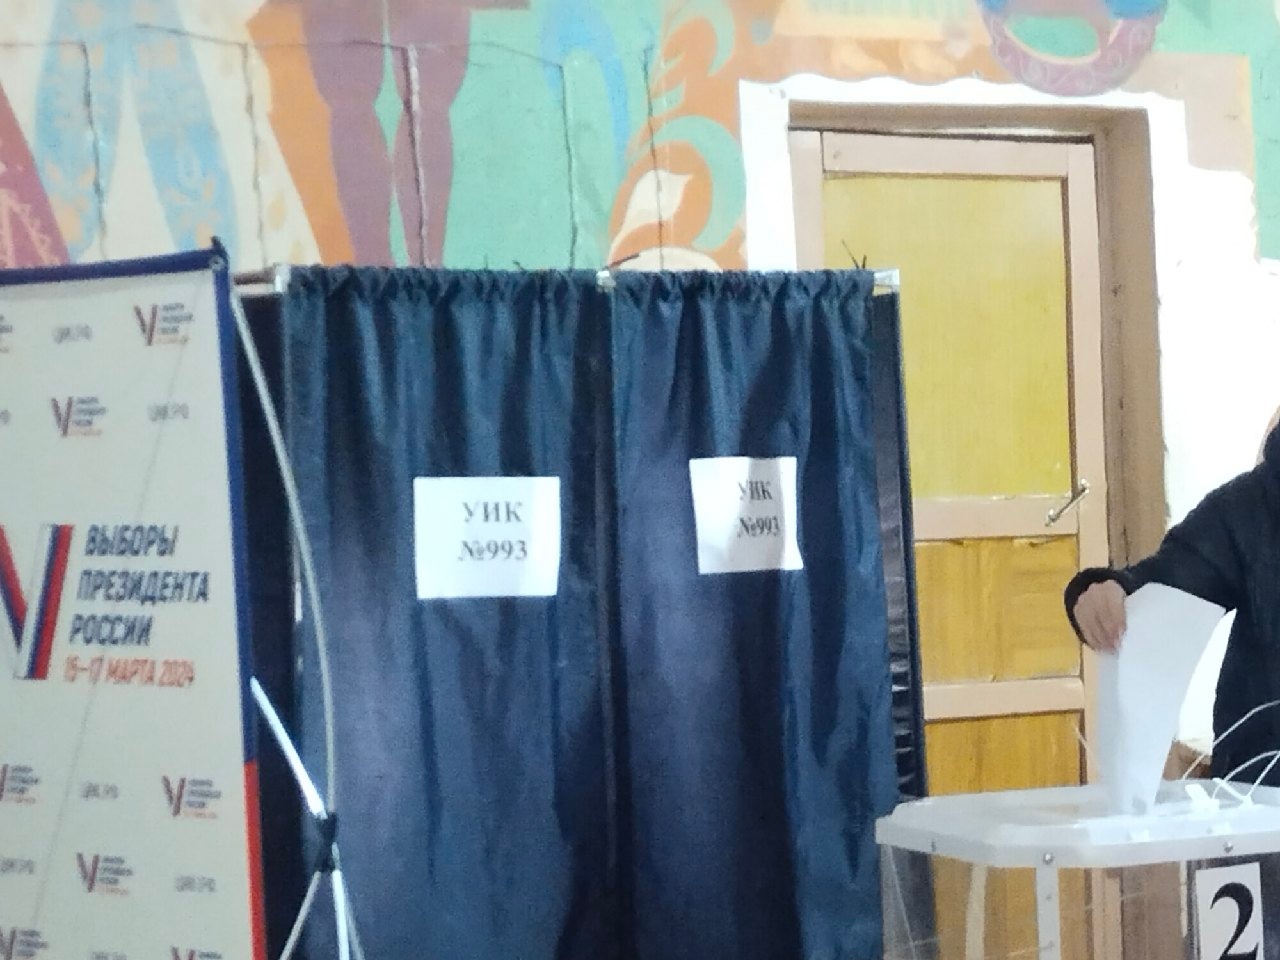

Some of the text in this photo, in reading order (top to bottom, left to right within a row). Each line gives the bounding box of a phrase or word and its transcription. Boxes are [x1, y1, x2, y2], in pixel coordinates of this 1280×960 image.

[461, 501, 523, 524] УИК
[85, 524, 180, 557] ВЫБОРЫ
[736, 516, 780, 538] №993
[457, 539, 528, 562] №993
[77, 569, 210, 606] ПРЕЗИДЕНТА
[69, 613, 153, 646] РОССИИ
